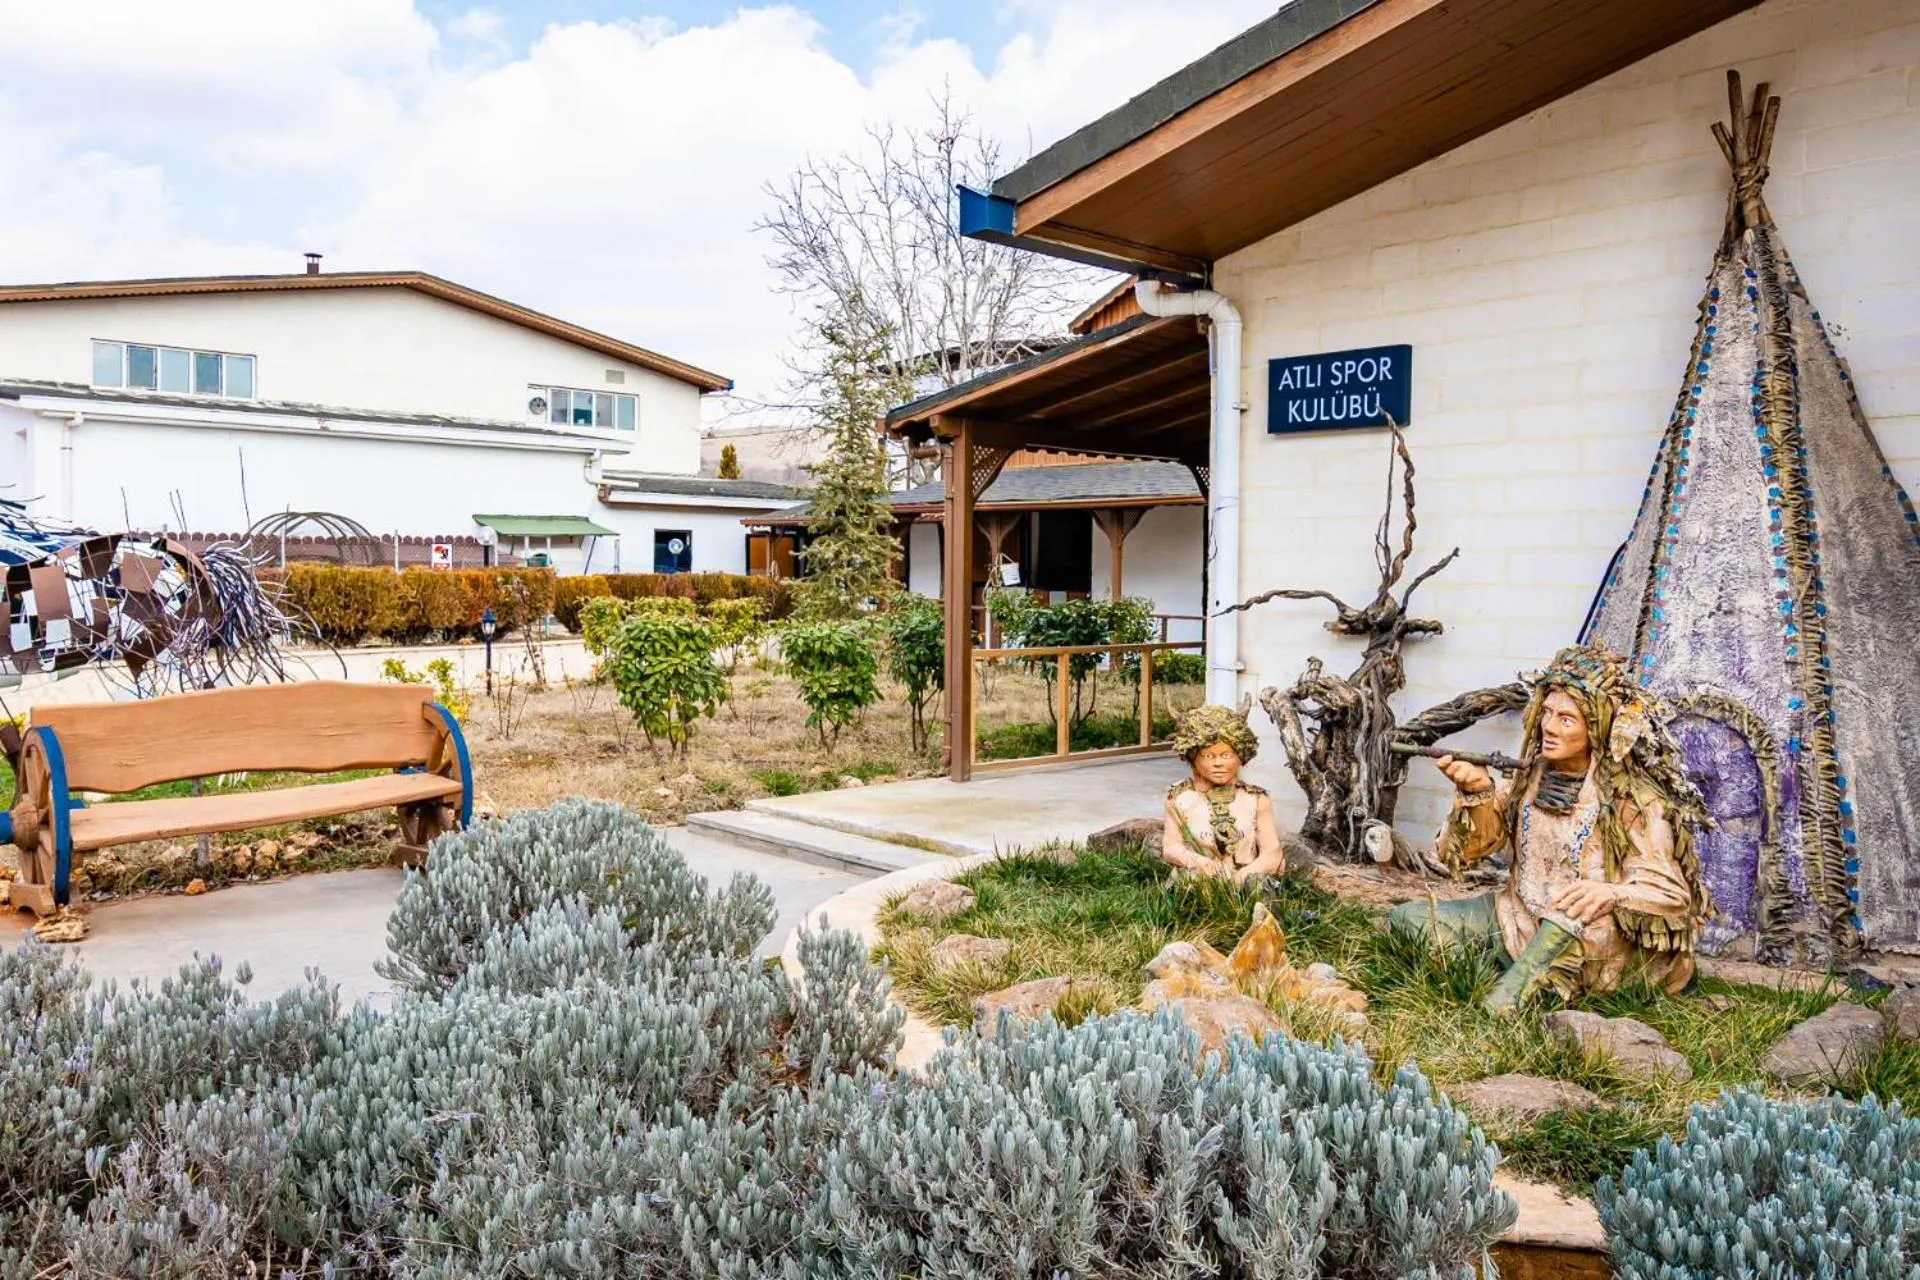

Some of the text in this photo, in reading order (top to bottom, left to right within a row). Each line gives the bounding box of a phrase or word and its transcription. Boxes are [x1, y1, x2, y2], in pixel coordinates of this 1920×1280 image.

[1278, 357, 1393, 391] ATLI SPOR
[1288, 387, 1380, 423] KULÜBÜ
